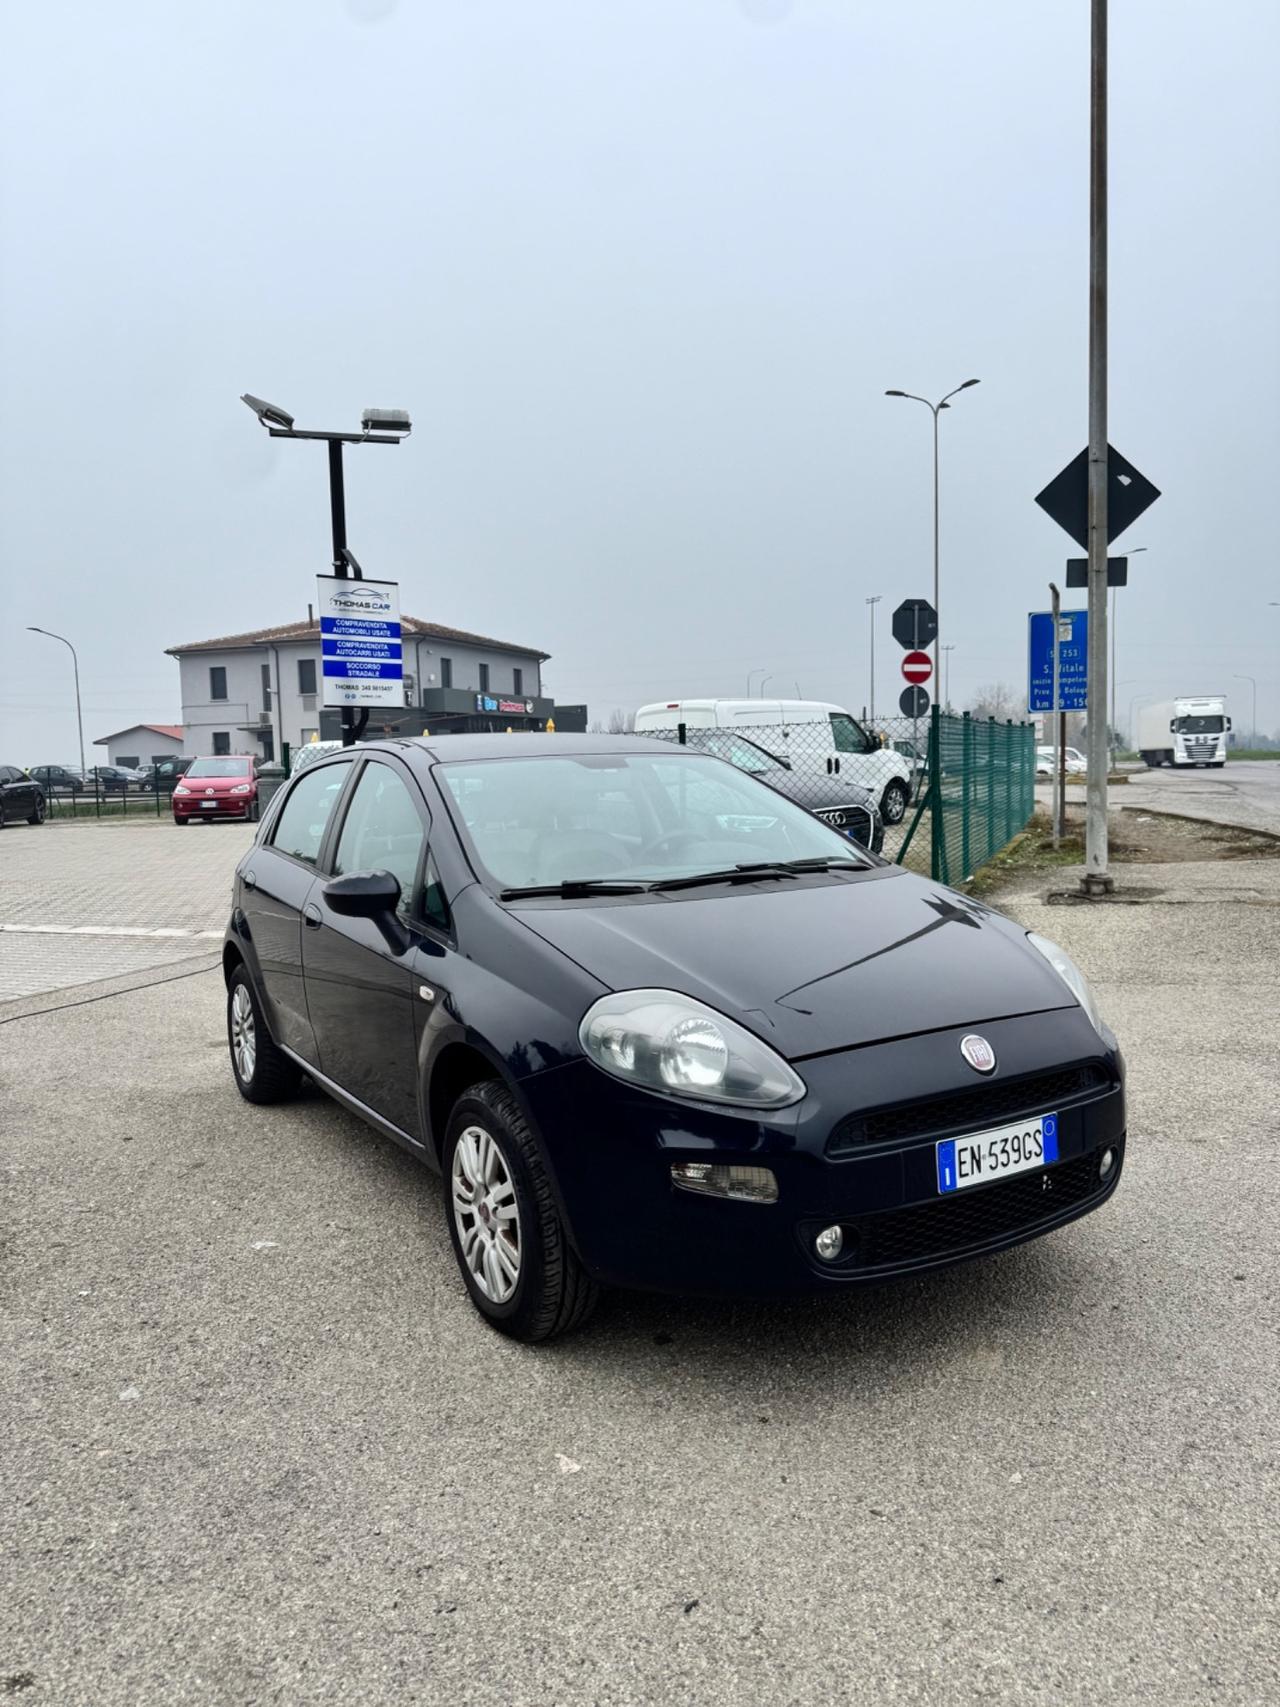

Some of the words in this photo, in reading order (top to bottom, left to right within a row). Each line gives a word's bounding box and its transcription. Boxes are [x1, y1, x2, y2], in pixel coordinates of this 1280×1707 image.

[333, 599, 371, 608] THOMAS
[371, 602, 391, 610] CAR
[335, 620, 387, 629] COMPRAVENDITA
[332, 627, 371, 636] AUTOMOBILI
[336, 641, 388, 650] COMPRAVENDITA
[335, 648, 371, 656] AUTOCARRI
[1062, 649, 1078, 657] 253
[346, 662, 381, 670] SOCCORSO
[347, 669, 380, 677] STRADALE
[1036, 700, 1049, 708] km
[958, 1144, 981, 1178] EN
[988, 1129, 1042, 1171] 539GS
